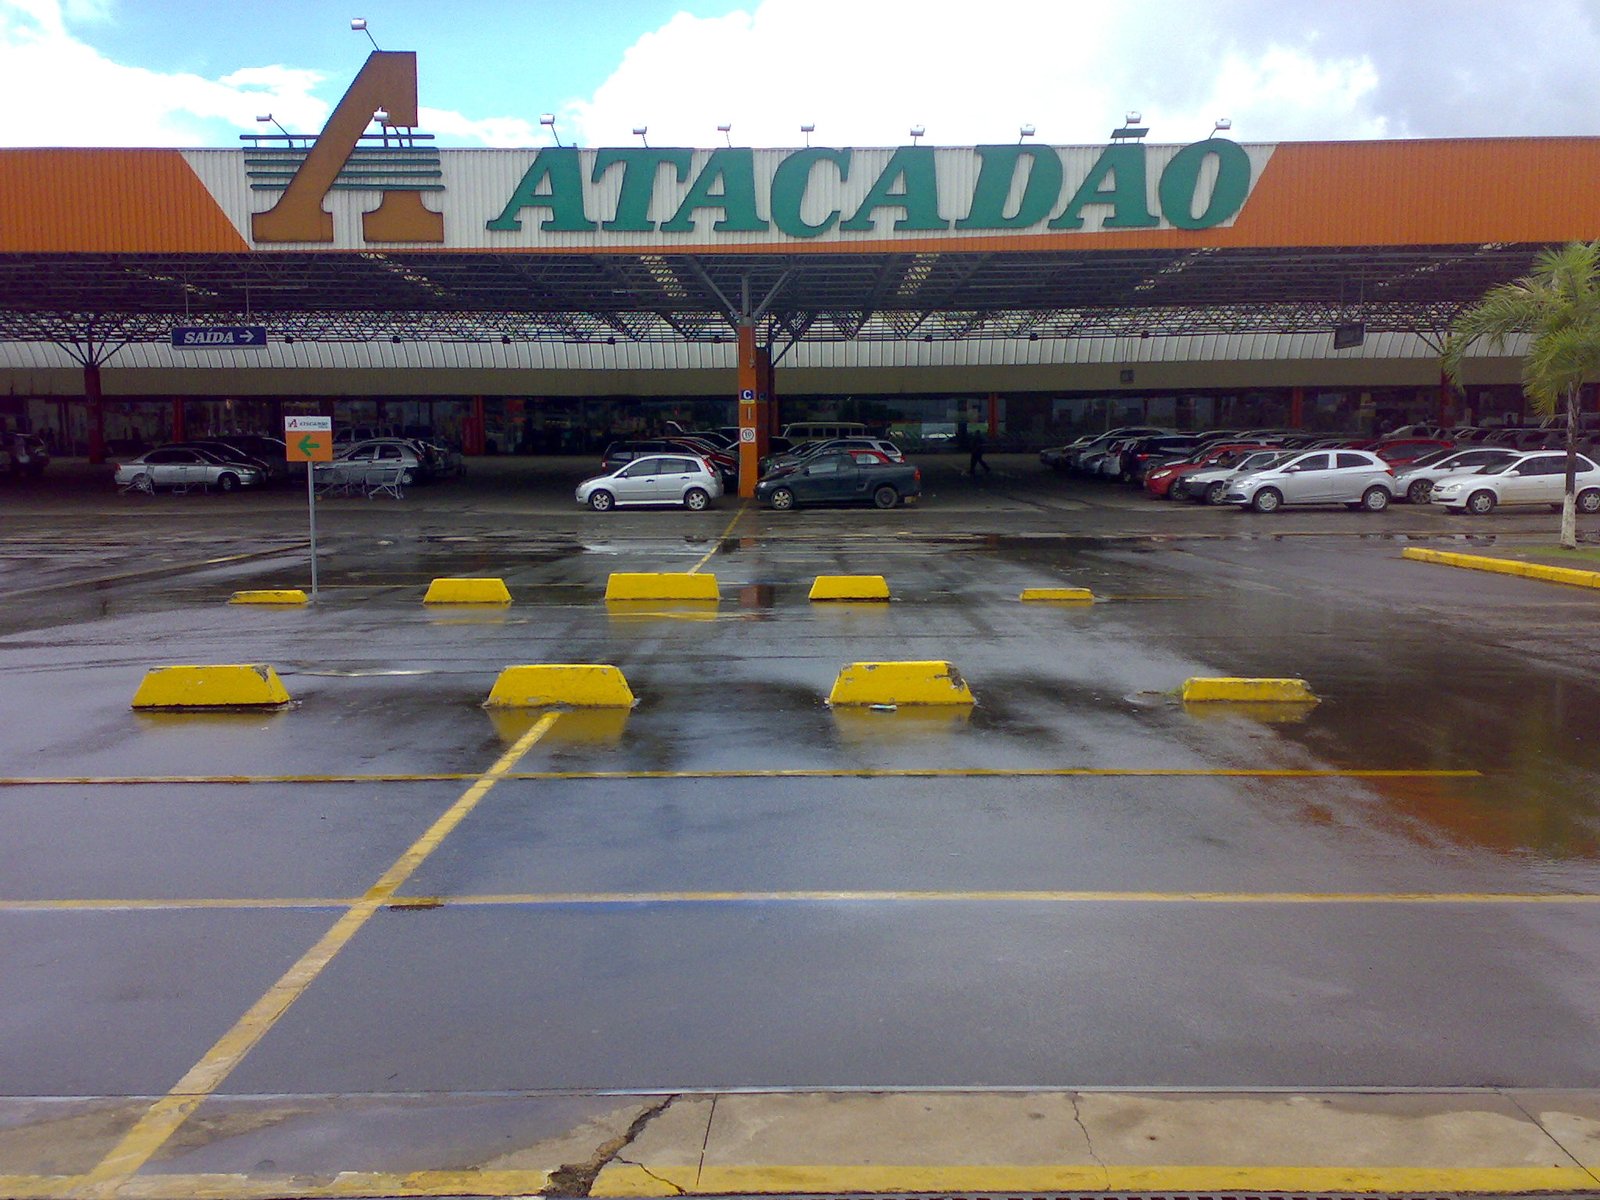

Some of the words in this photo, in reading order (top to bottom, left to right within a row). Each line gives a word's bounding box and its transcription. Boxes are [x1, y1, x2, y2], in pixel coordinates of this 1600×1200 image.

[486, 128, 1252, 238] ATACADÃO
[184, 328, 235, 344] SAÍDA
[743, 390, 752, 400] C
